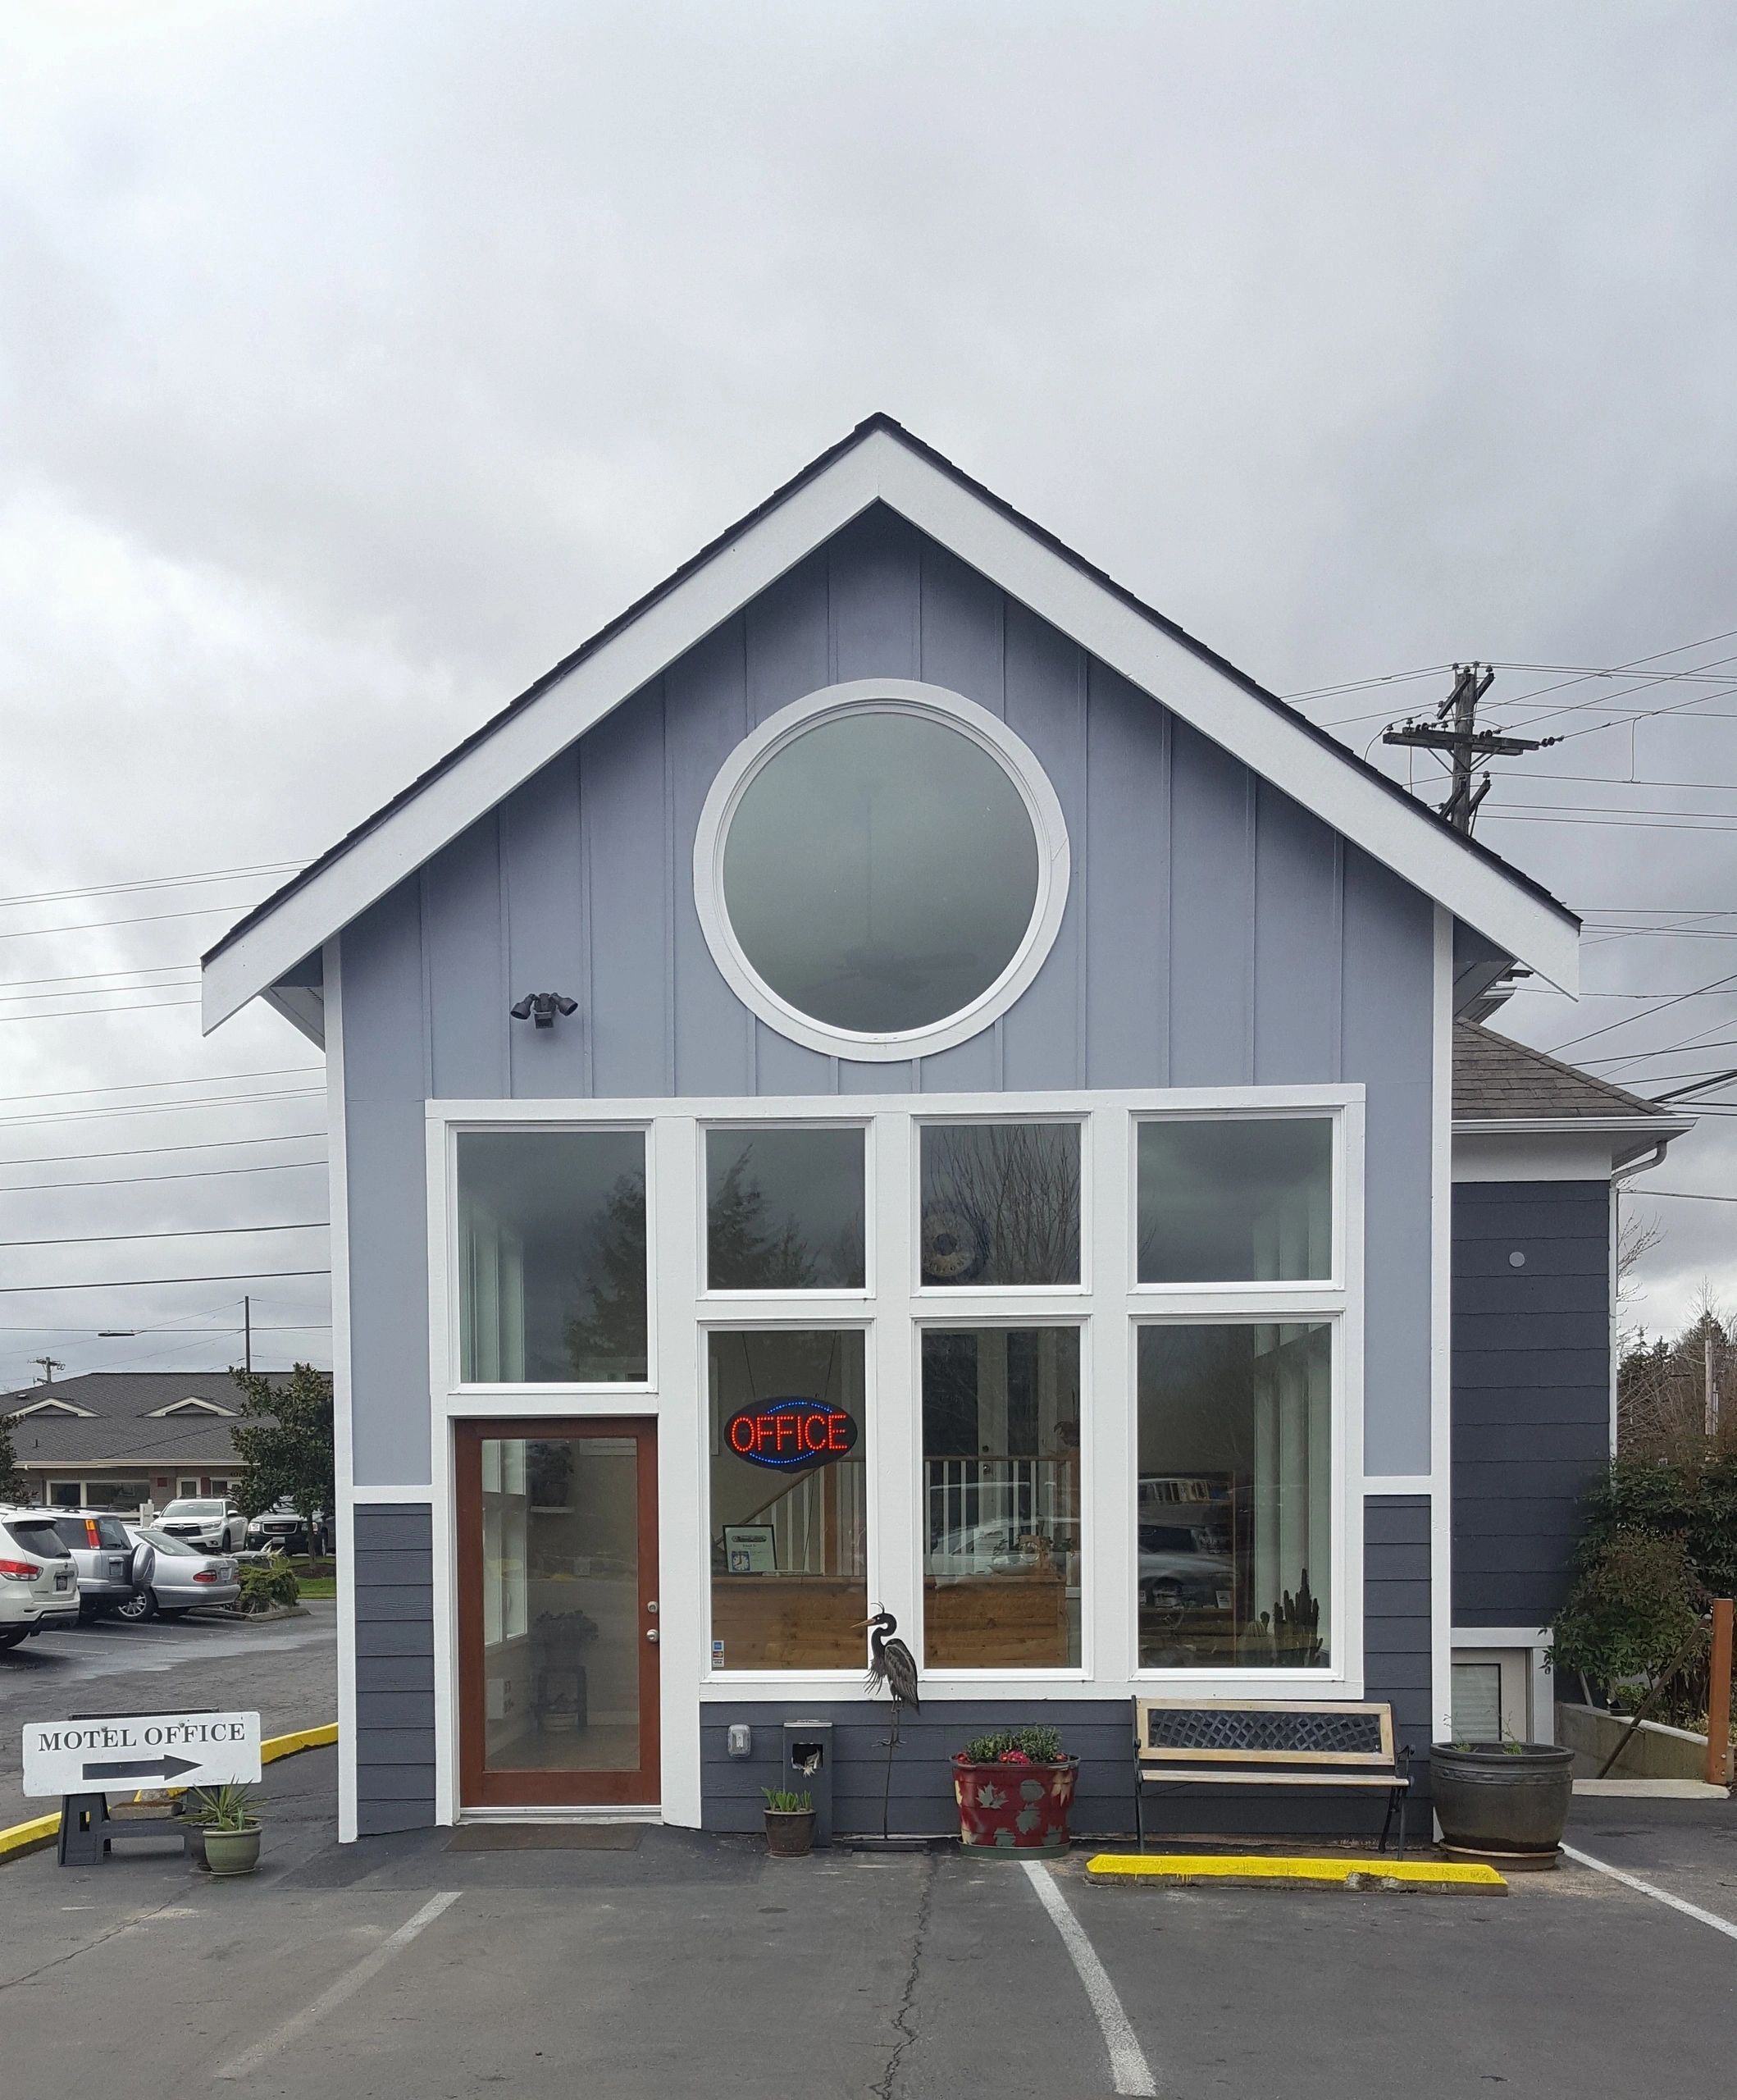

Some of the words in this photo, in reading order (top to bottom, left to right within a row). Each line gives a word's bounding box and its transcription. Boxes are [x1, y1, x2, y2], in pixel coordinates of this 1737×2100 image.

[731, 1414, 848, 1452] OFFICE
[38, 1728, 137, 1751] MOTEL
[144, 1723, 245, 1746] OFFICE
